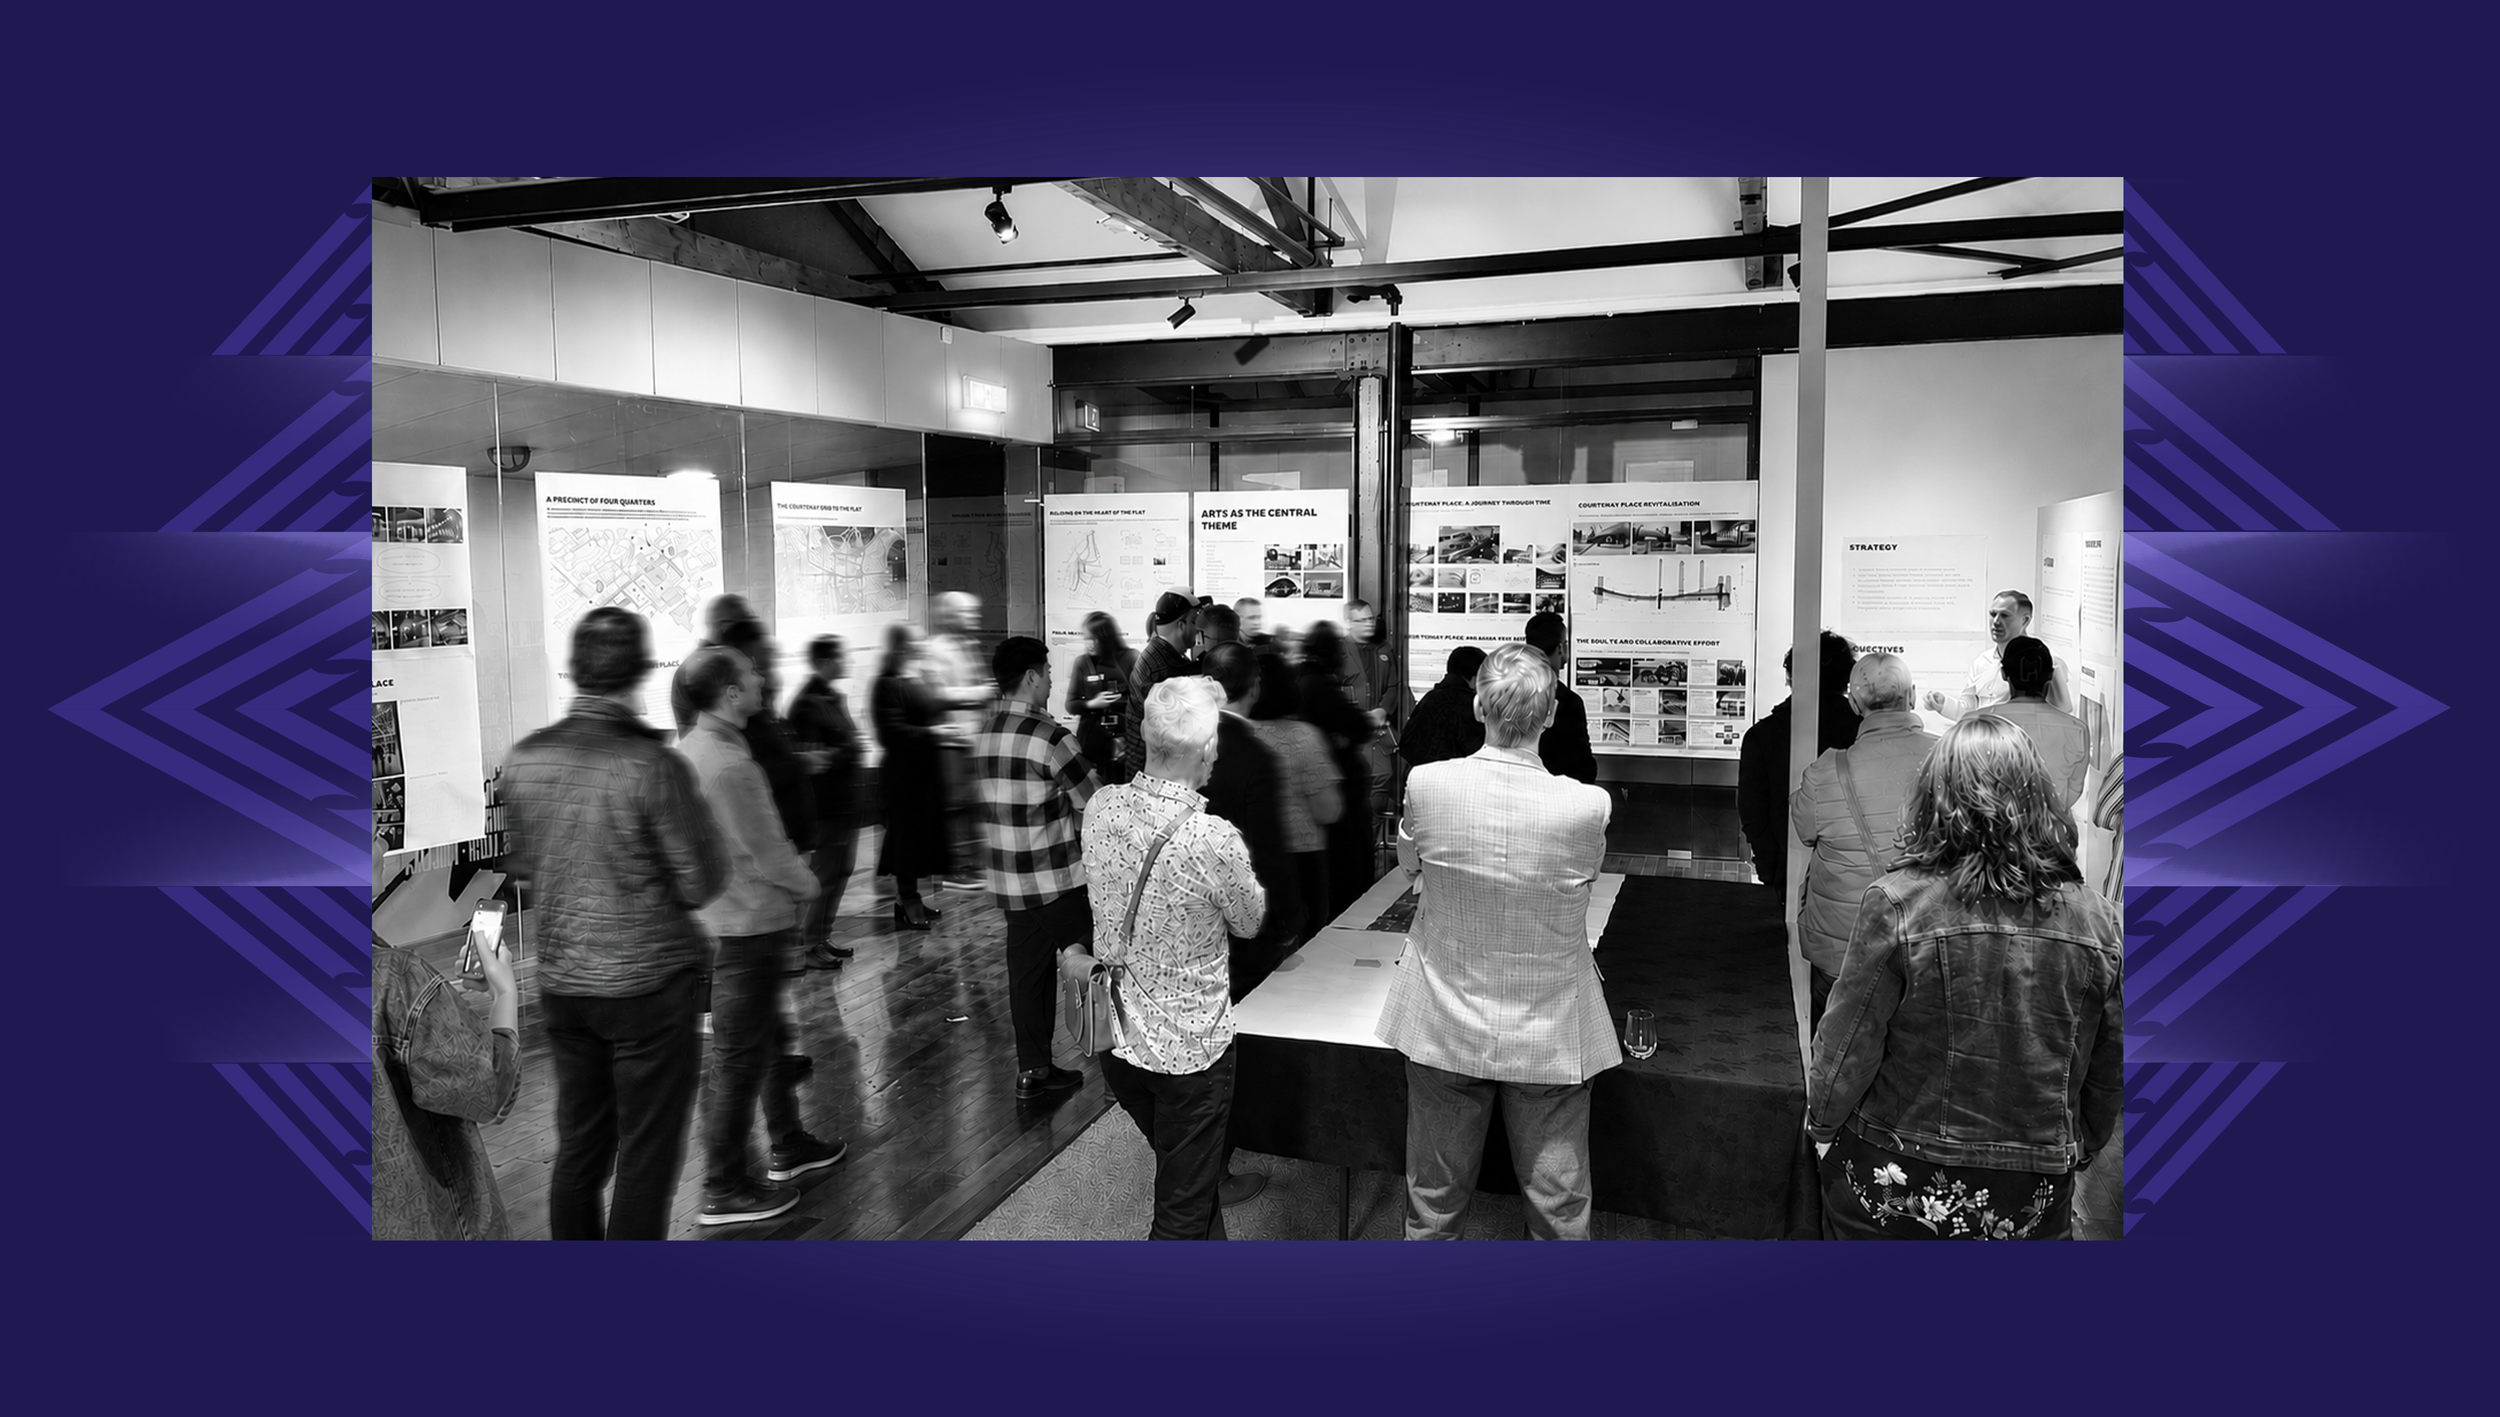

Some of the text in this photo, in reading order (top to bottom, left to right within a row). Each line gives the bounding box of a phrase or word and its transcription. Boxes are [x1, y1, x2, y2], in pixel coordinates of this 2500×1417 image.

[553, 496, 589, 504] PRECINCT
[1201, 508, 1318, 518] ARTS AS THE CENTRAL
[1201, 521, 1238, 530] THEME
